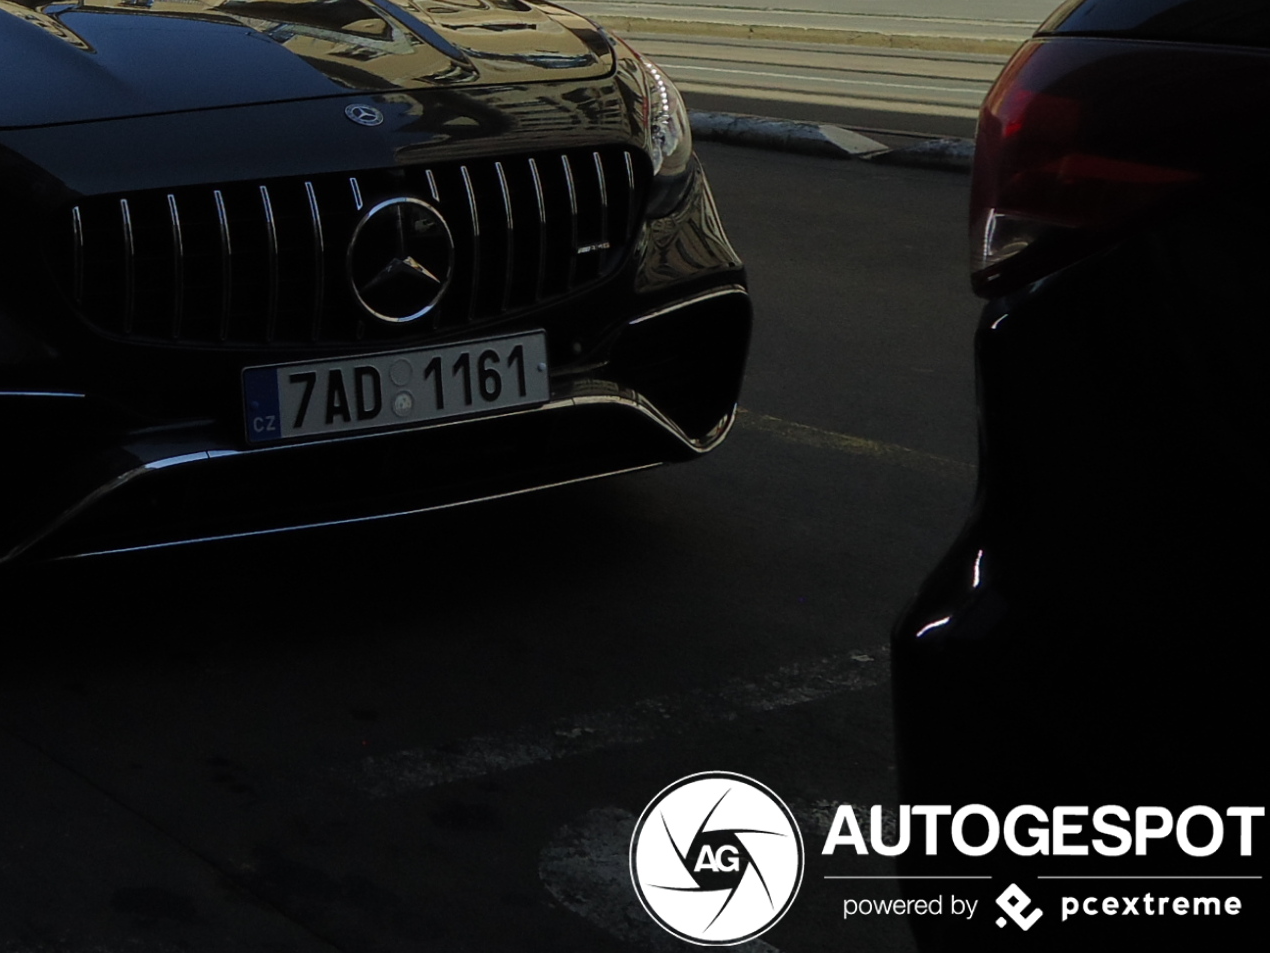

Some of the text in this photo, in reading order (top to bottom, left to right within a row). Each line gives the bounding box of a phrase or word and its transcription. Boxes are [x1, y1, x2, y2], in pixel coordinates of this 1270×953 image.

[288, 344, 528, 430] 7AD 1161
[253, 414, 276, 434] CZ
